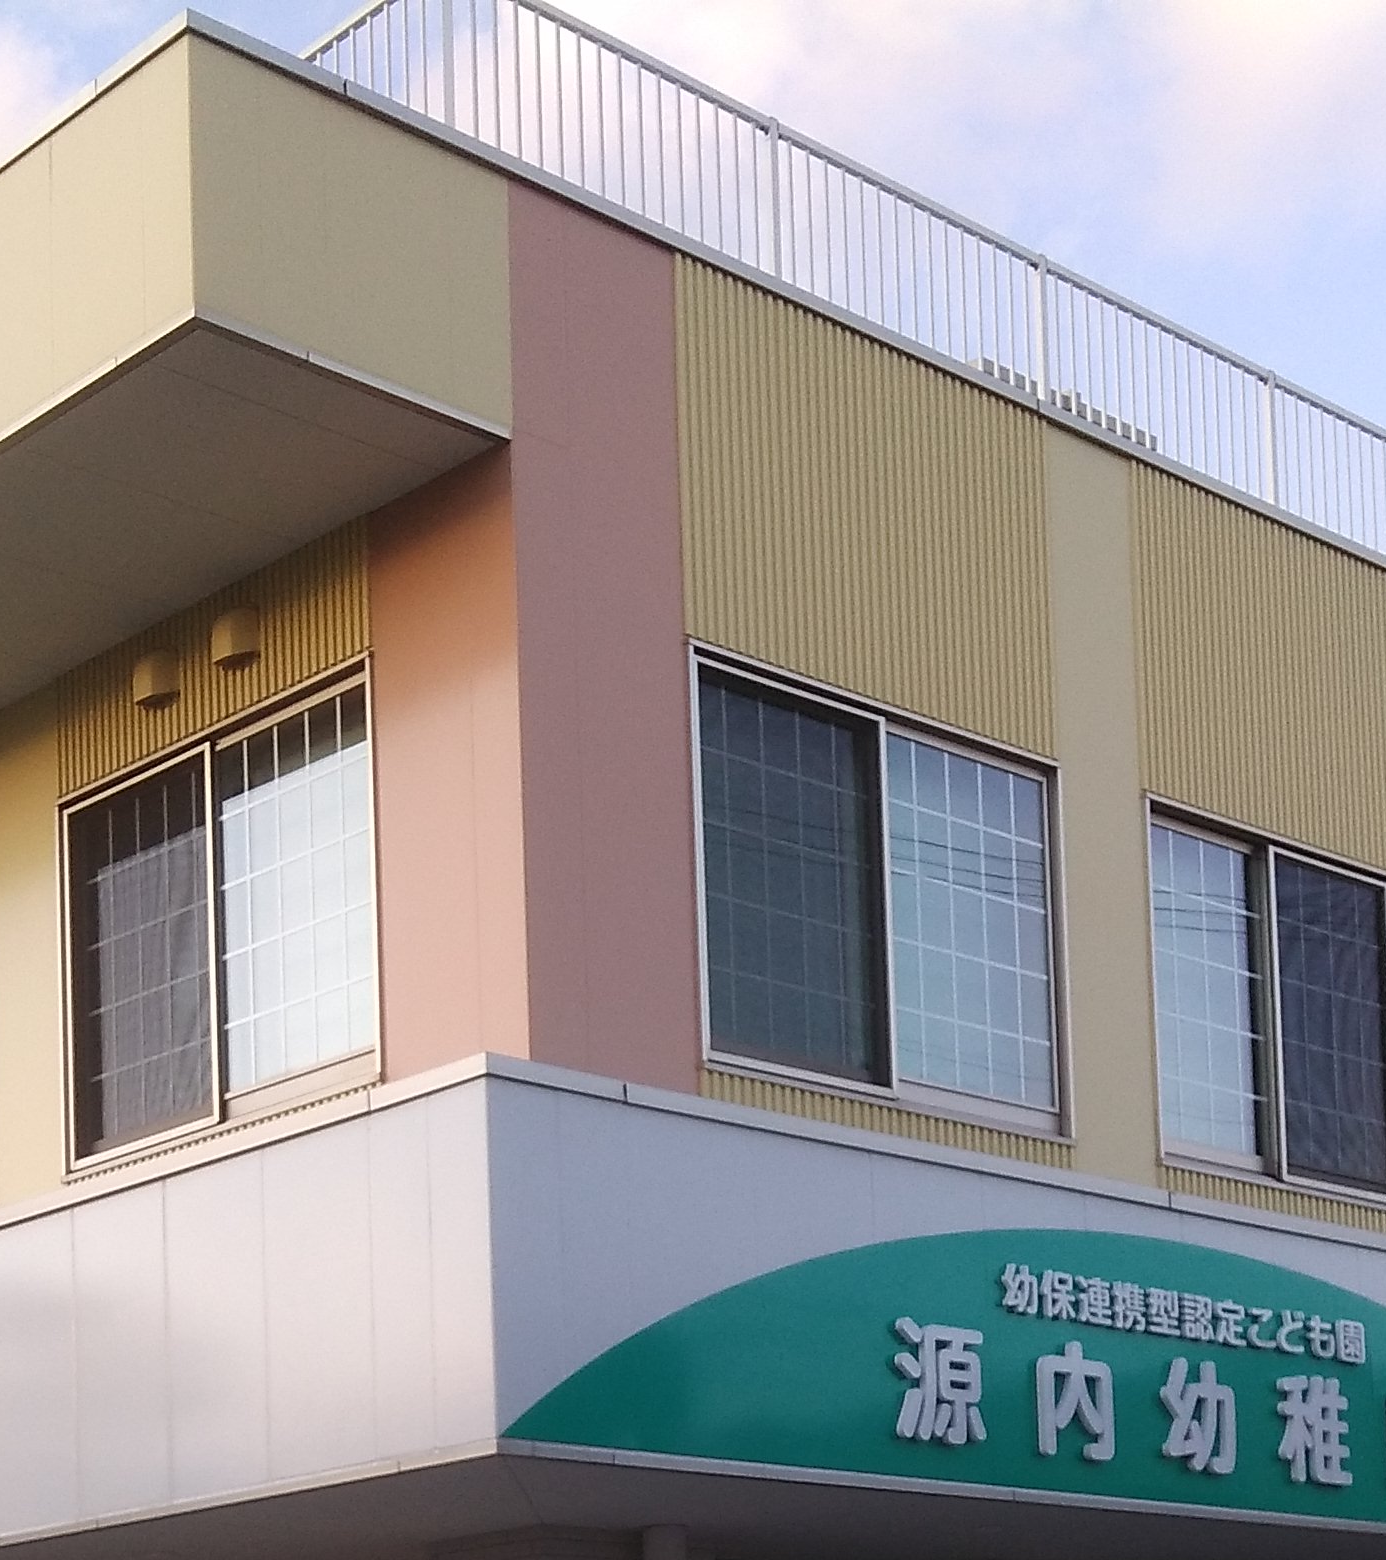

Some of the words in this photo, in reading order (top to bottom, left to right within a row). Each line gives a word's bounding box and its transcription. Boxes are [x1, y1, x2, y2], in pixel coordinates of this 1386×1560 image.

[1000, 1262, 1367, 1366] 幼保連携型認定こども園
